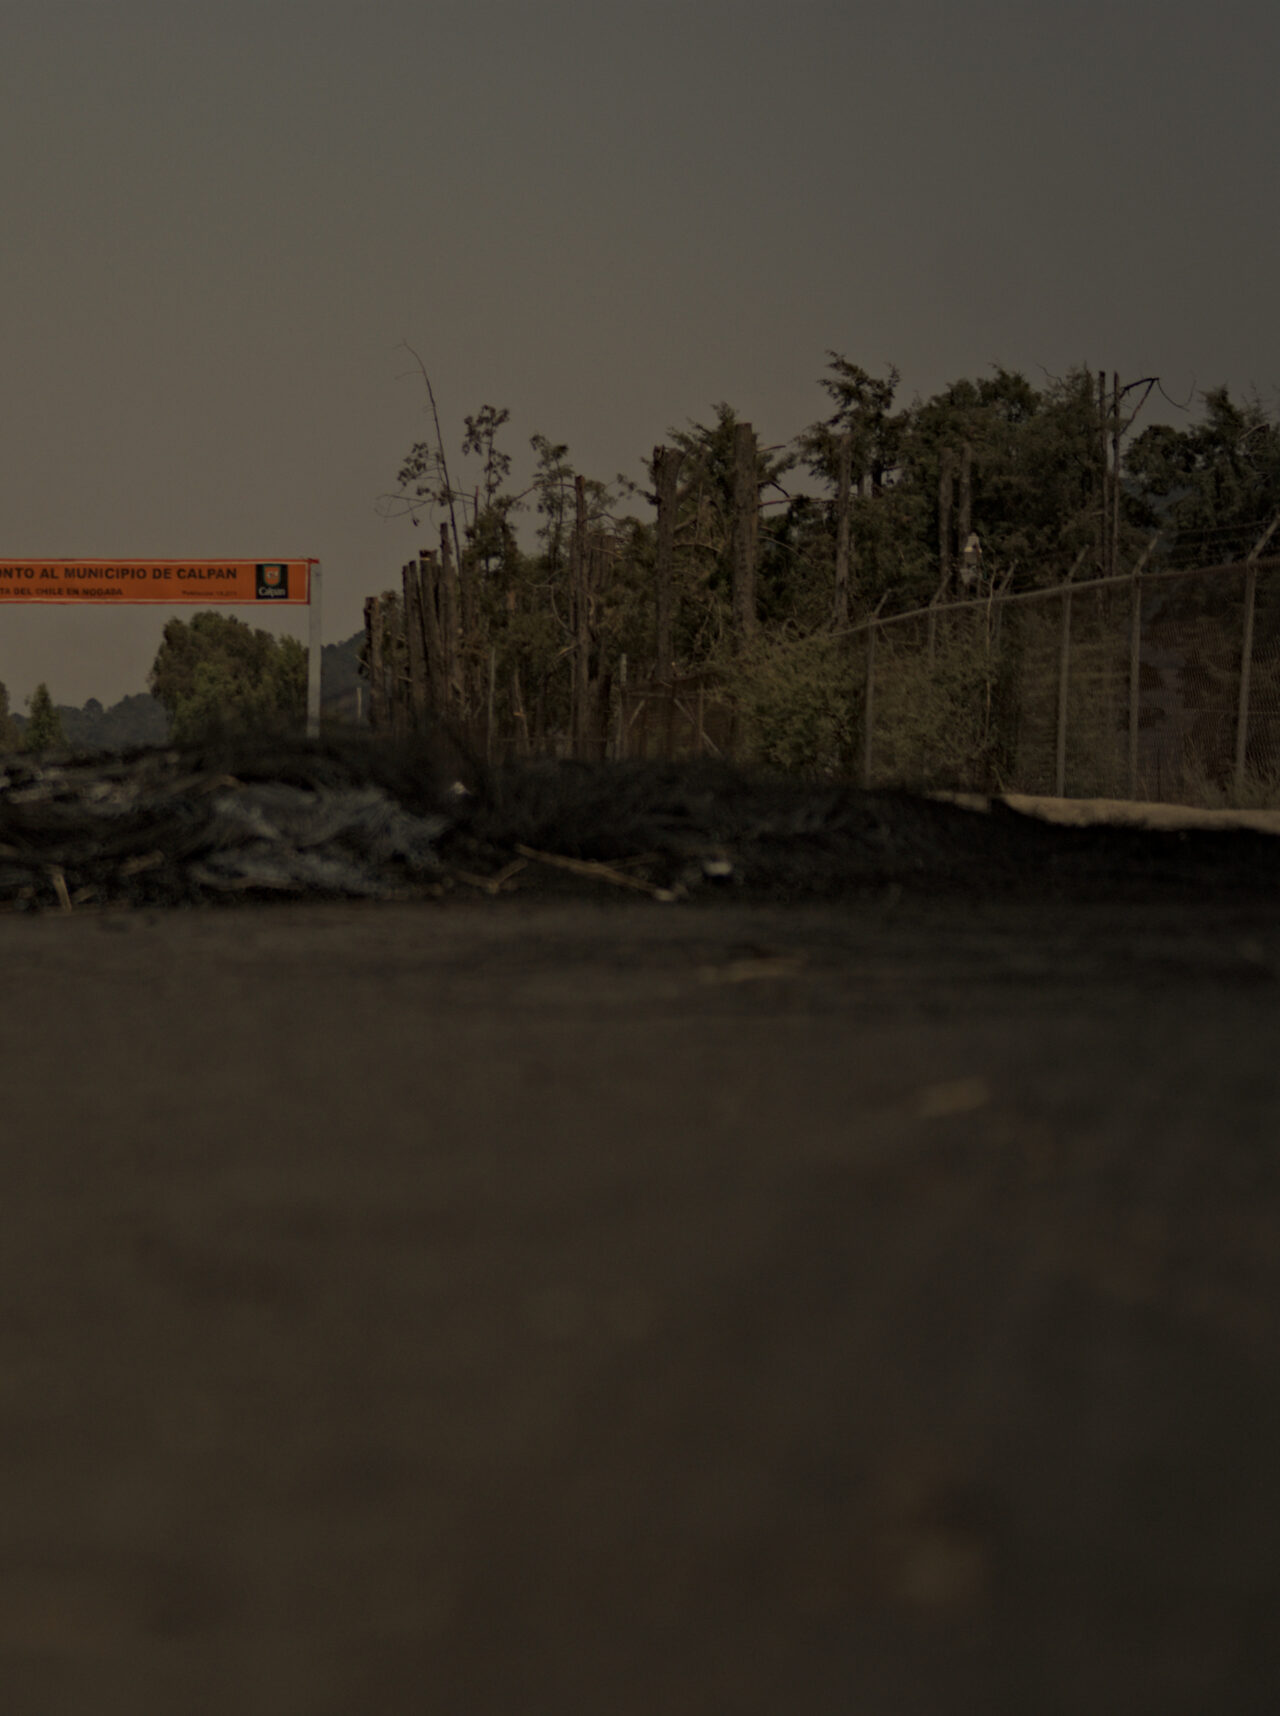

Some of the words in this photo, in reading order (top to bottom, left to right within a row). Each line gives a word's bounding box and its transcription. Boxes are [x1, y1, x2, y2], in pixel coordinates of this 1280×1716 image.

[39, 568, 59, 579] AL
[64, 568, 147, 579] MUNICIPIO
[152, 568, 171, 579] DE
[176, 568, 237, 580] CALPAN
[14, 587, 32, 596] DEL
[35, 587, 64, 596] CHILE
[66, 587, 79, 596] EN
